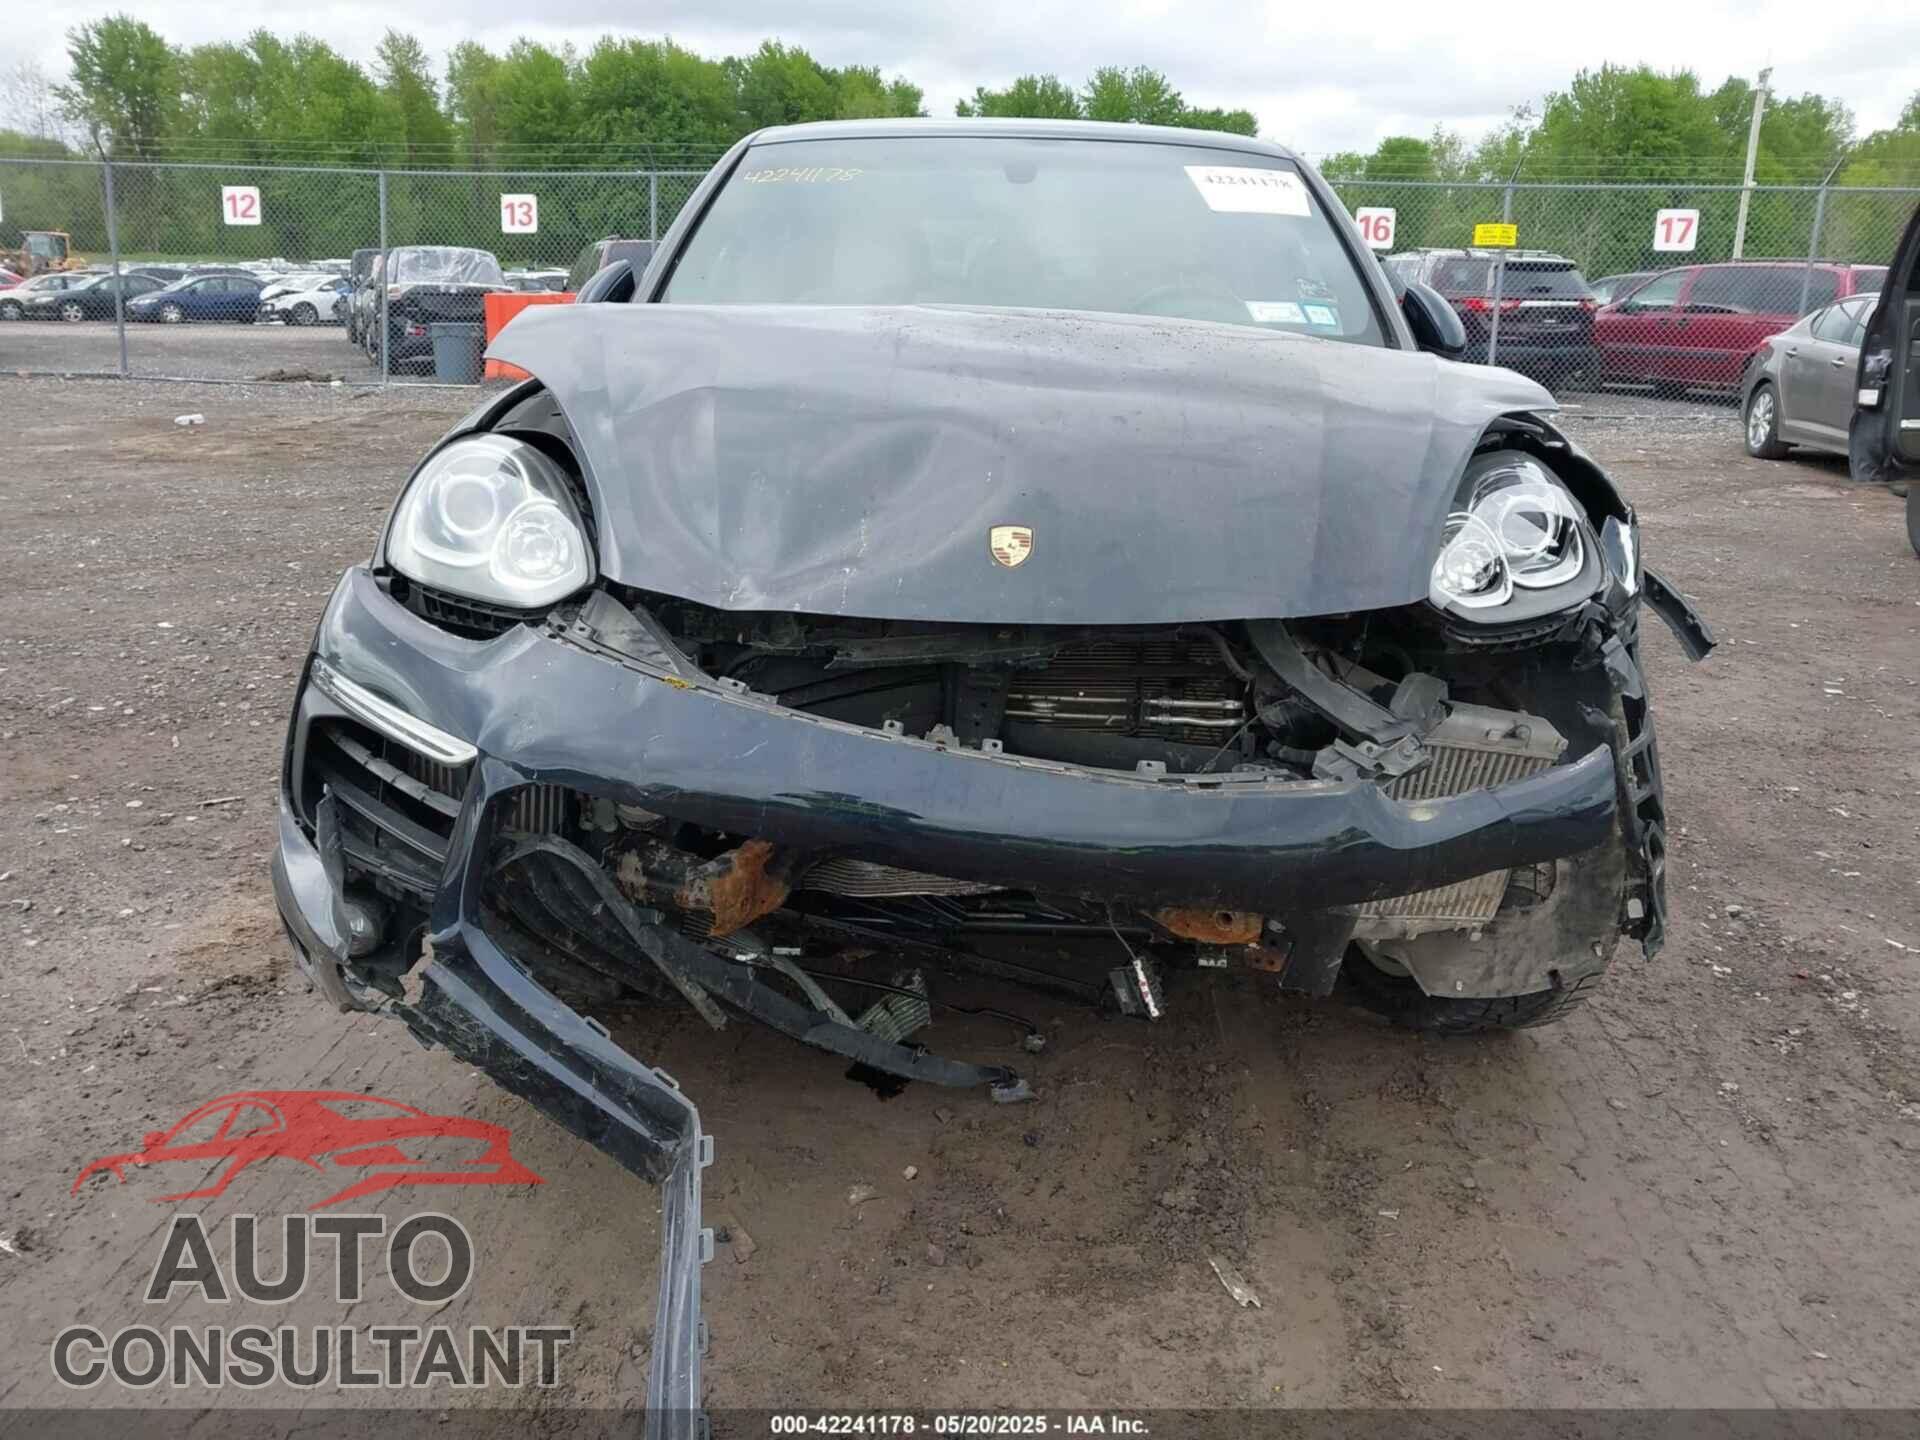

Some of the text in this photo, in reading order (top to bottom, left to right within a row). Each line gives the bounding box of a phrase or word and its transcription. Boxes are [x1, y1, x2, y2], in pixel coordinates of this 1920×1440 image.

[743, 167, 864, 184] 42241178
[226, 194, 257, 218] 12
[504, 201, 533, 226] 13
[1359, 215, 1391, 241] 16
[1661, 217, 1694, 243] 17
